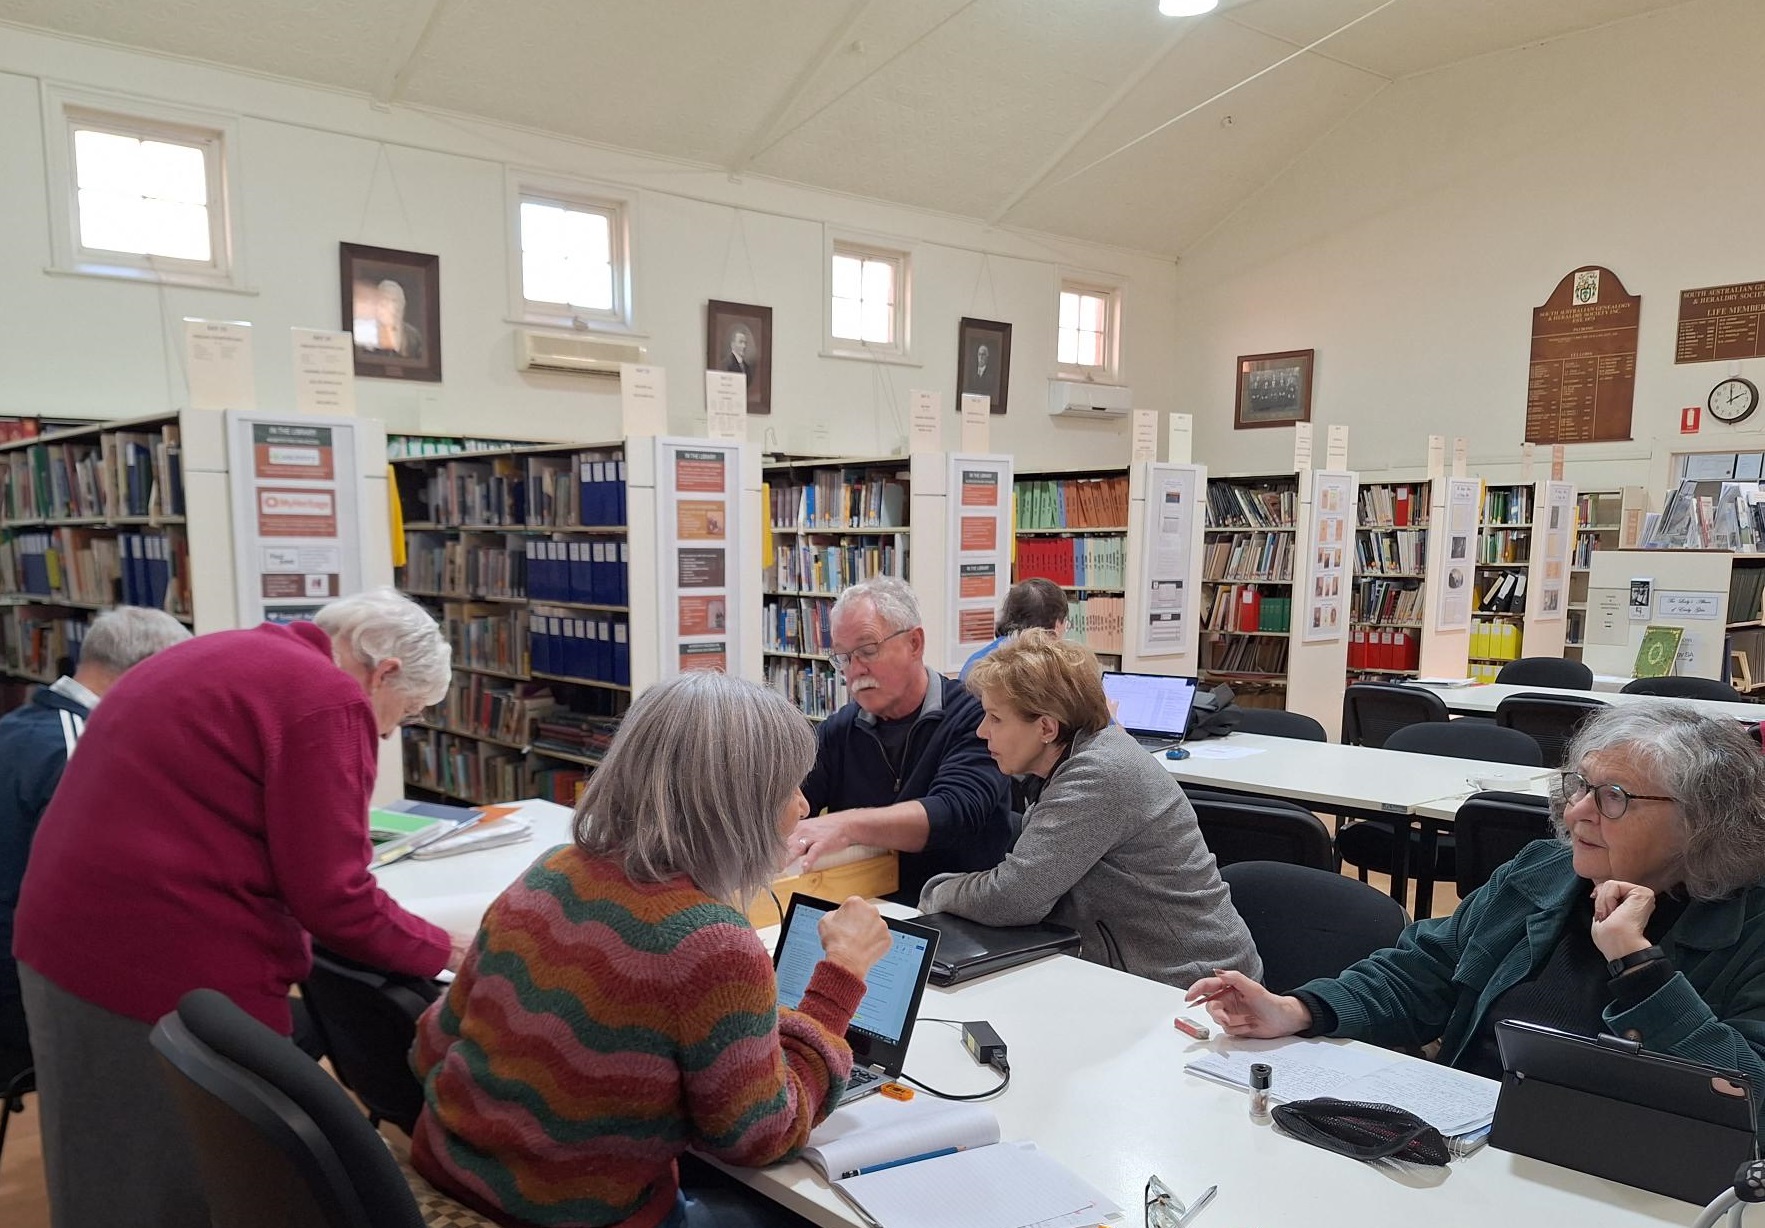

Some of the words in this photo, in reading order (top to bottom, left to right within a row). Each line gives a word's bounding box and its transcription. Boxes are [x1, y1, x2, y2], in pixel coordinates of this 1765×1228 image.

[1683, 290, 1707, 298] SOUTH
[1709, 285, 1753, 296] AUSTRALIAN
[1700, 294, 1738, 304] HERALDRY
[1706, 307, 1728, 318] LIFE
